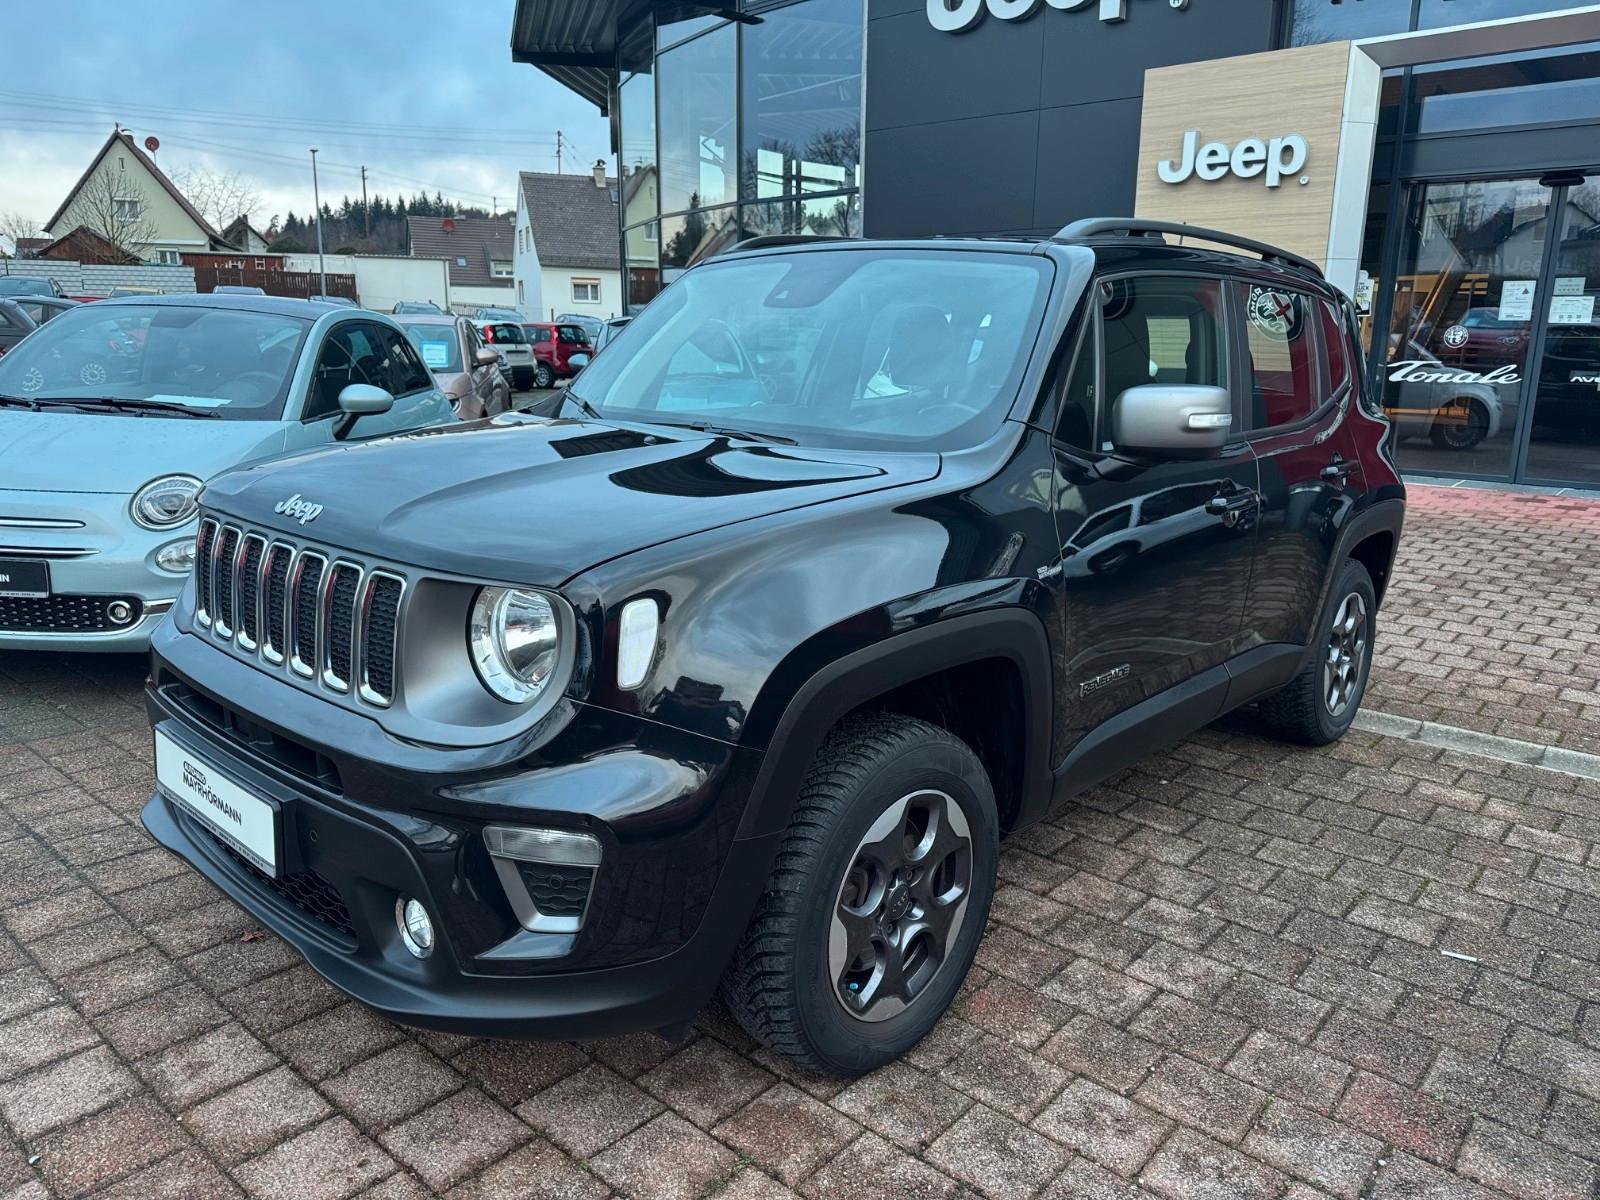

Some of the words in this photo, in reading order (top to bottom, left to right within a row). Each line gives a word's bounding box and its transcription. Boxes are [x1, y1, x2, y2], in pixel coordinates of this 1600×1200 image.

[1157, 130, 1309, 189] Jeep
[1387, 360, 1522, 385] Tonale
[274, 493, 324, 526] Jeep
[182, 772, 242, 826] MAYRHÖRMANN
